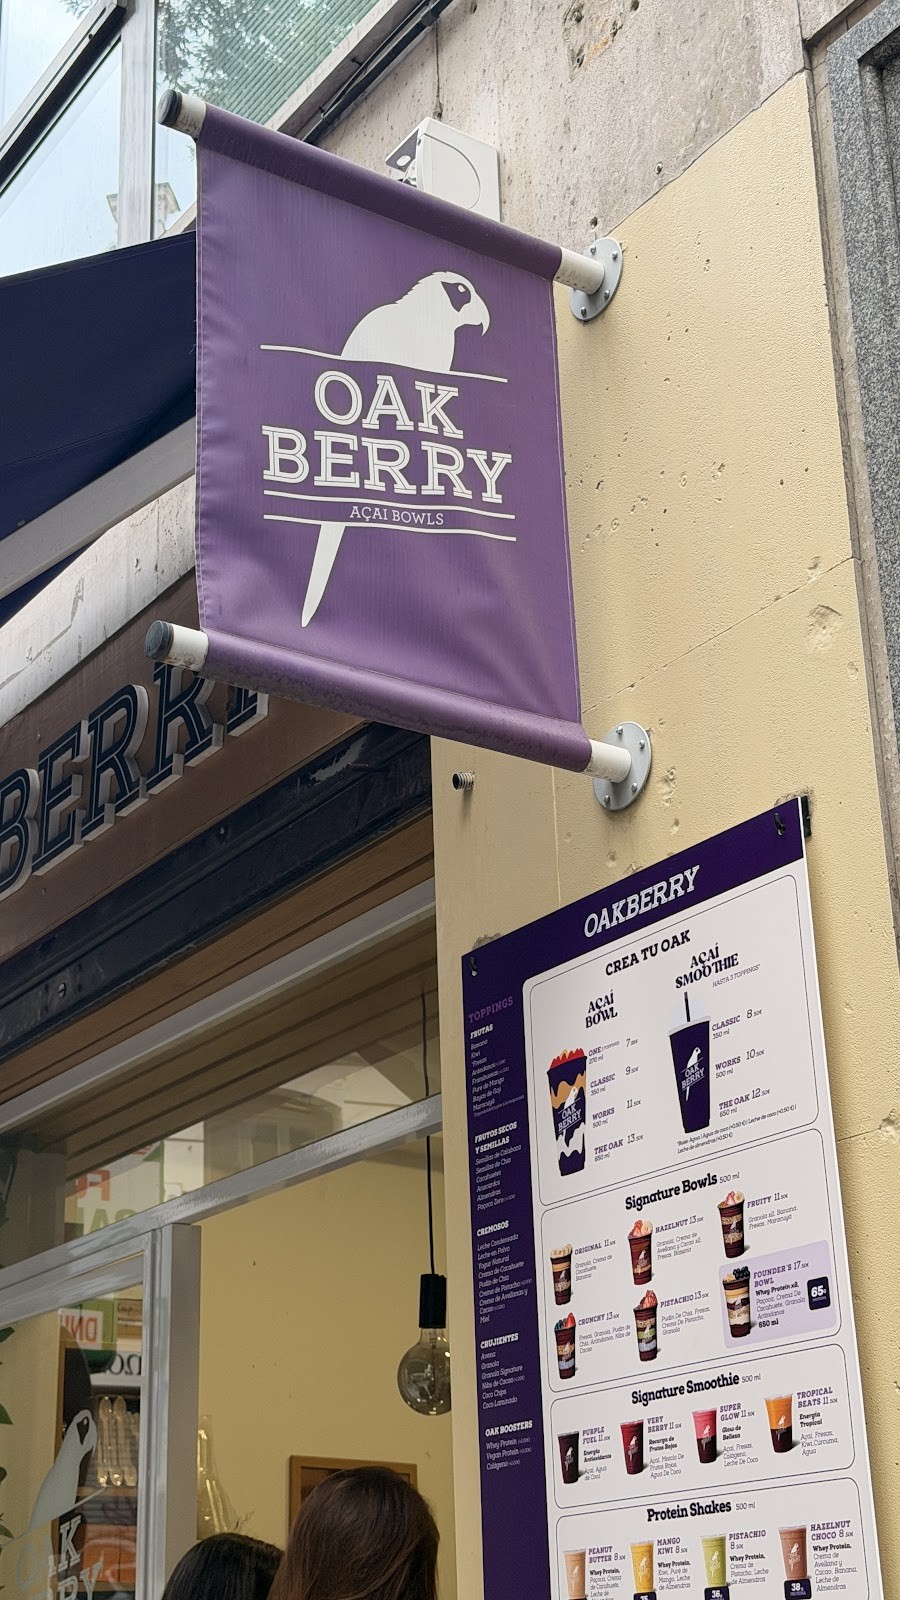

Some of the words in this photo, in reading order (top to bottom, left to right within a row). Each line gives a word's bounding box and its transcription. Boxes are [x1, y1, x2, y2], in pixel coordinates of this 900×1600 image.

[315, 370, 463, 439] OAK
[262, 425, 512, 503] BERRY
[350, 506, 388, 521] AÇAI
[392, 510, 443, 525] BOWLS
[0, 661, 269, 900] BERR
[584, 865, 699, 939] OAKBERRY
[605, 951, 639, 977] CREA
[641, 943, 657, 961] TU
[661, 928, 690, 953] OAK
[690, 943, 719, 969] AÇAÍ
[675, 952, 738, 990] SMOOTHIE
[468, 995, 513, 1023] TOPPINGS
[587, 990, 613, 1014] AÇAÍ
[585, 1004, 617, 1029] BOWL
[712, 1014, 740, 1031] CLASSIC
[470, 1023, 493, 1039] FRUTAS
[712, 1031, 722, 1039] 350
[588, 1046, 601, 1057] ONE
[685, 1061, 699, 1078] OAK
[715, 1056, 740, 1070] WORKS
[681, 1067, 704, 1089] BERRY
[716, 1070, 725, 1078] 500
[727, 1067, 733, 1075] ml
[590, 1072, 615, 1088] CLASSIC
[719, 1099, 732, 1110] THE
[734, 1093, 749, 1105] OAK
[561, 1103, 576, 1120] OAK
[592, 1107, 614, 1120] WORKS
[558, 1108, 581, 1131] BERRY
[474, 1128, 497, 1143] FRUTOS
[498, 1121, 517, 1134] SECOS
[475, 1146, 479, 1154] Y
[479, 1135, 509, 1152] SEMILLAS
[594, 1143, 607, 1155] THE
[608, 1138, 623, 1150] OAK
[625, 1187, 680, 1211] Signature
[682, 1173, 717, 1193] Bowls
[719, 1173, 730, 1183] 500
[732, 1171, 739, 1179] ml
[747, 1195, 771, 1208] FRUITY
[476, 1220, 508, 1237] CREMOSOS
[655, 1218, 687, 1233] HAZELNUT
[574, 1242, 601, 1255] ORIGINAL
[754, 1277, 773, 1287] BOWL
[755, 1287, 769, 1296] Whey
[771, 1283, 790, 1292] Protein
[660, 1294, 693, 1307] PISTACHIO
[578, 1313, 604, 1325] CRUNCHY
[758, 1319, 769, 1328] 650
[771, 1317, 778, 1325] ml
[480, 1332, 518, 1349] CRUJIENTES
[632, 1384, 684, 1406] Signature
[686, 1372, 739, 1394] Smoothie
[741, 1374, 752, 1383] 500
[753, 1373, 760, 1381] ml
[796, 1386, 832, 1399] TROPICAL
[720, 1402, 741, 1412] SUPER
[797, 1397, 820, 1408] BEATS
[647, 1415, 663, 1424] VERY
[720, 1411, 739, 1421] GLOW
[800, 1418, 822, 1427] Tropical
[485, 1426, 499, 1436] OAK
[500, 1419, 532, 1433] BOOSTERS
[582, 1426, 604, 1436] PURPLE
[647, 1423, 667, 1432] BERRY
[722, 1425, 734, 1433] Glow
[582, 1436, 596, 1444] FUEL
[647, 1504, 687, 1522] Protein
[689, 1500, 731, 1516] Shakes
[736, 1502, 746, 1510] 500
[810, 1520, 850, 1531] HAZELNUT
[657, 1536, 680, 1546] MANGO
[729, 1529, 765, 1540] PISTACHIO
[811, 1531, 836, 1540] CHOCO
[588, 1545, 612, 1554] PEANUT
[812, 1544, 828, 1552] Whey
[589, 1554, 611, 1563] BUTTER
